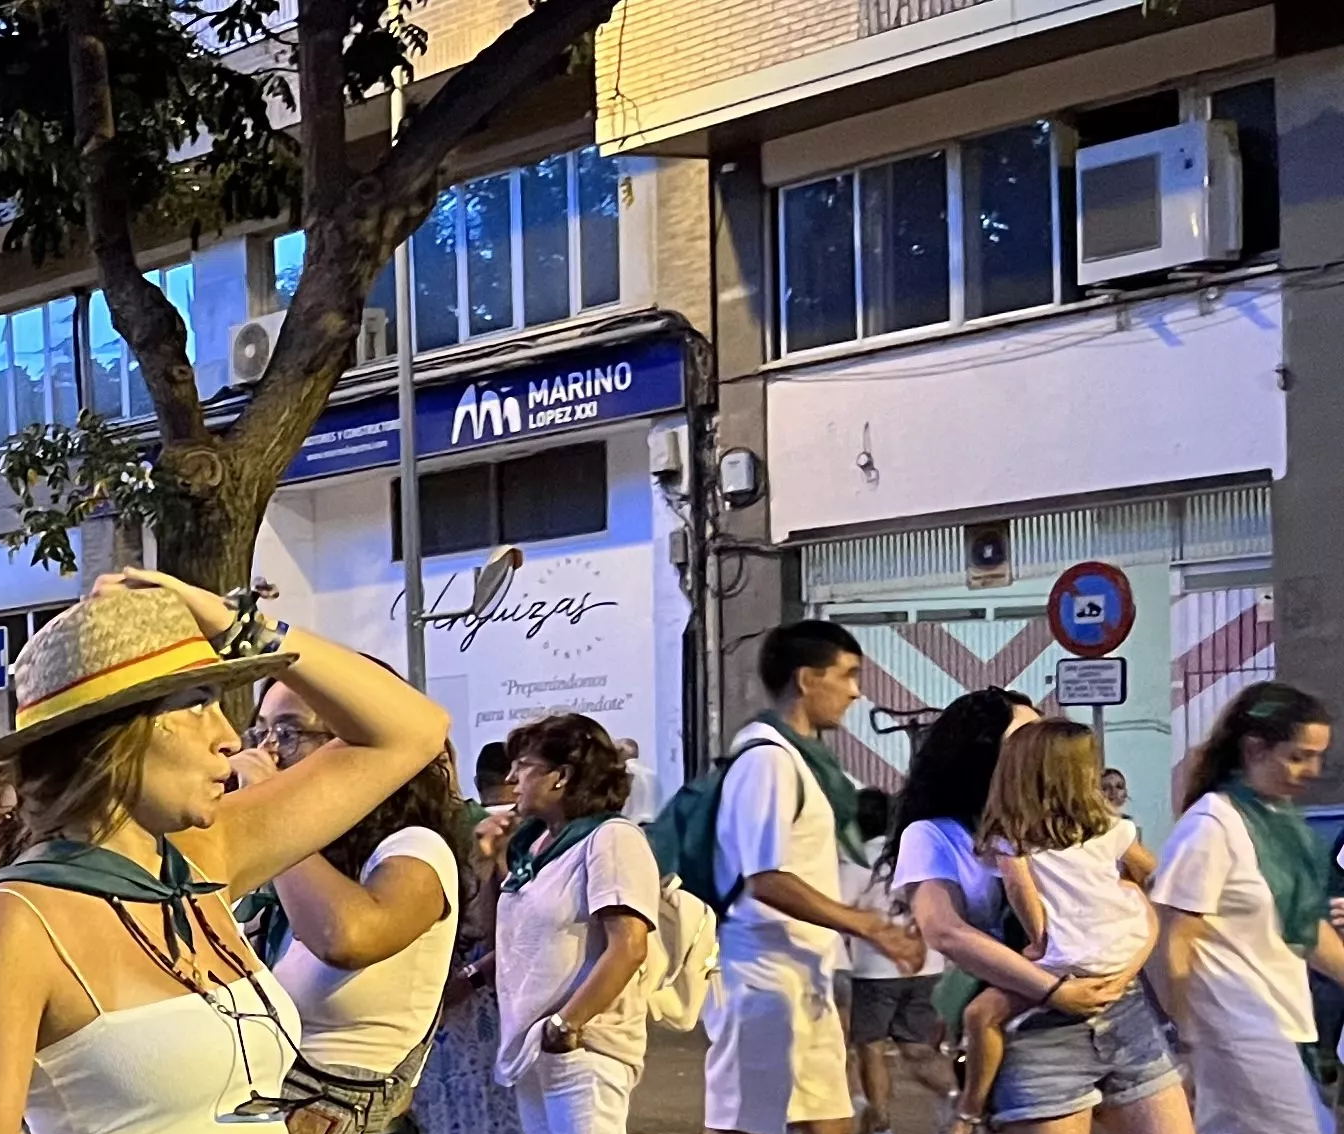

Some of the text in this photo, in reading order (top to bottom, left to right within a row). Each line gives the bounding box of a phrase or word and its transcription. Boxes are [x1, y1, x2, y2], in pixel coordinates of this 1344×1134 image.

[528, 361, 632, 409] MARINO
[528, 401, 598, 430] LOPEZ XXI
